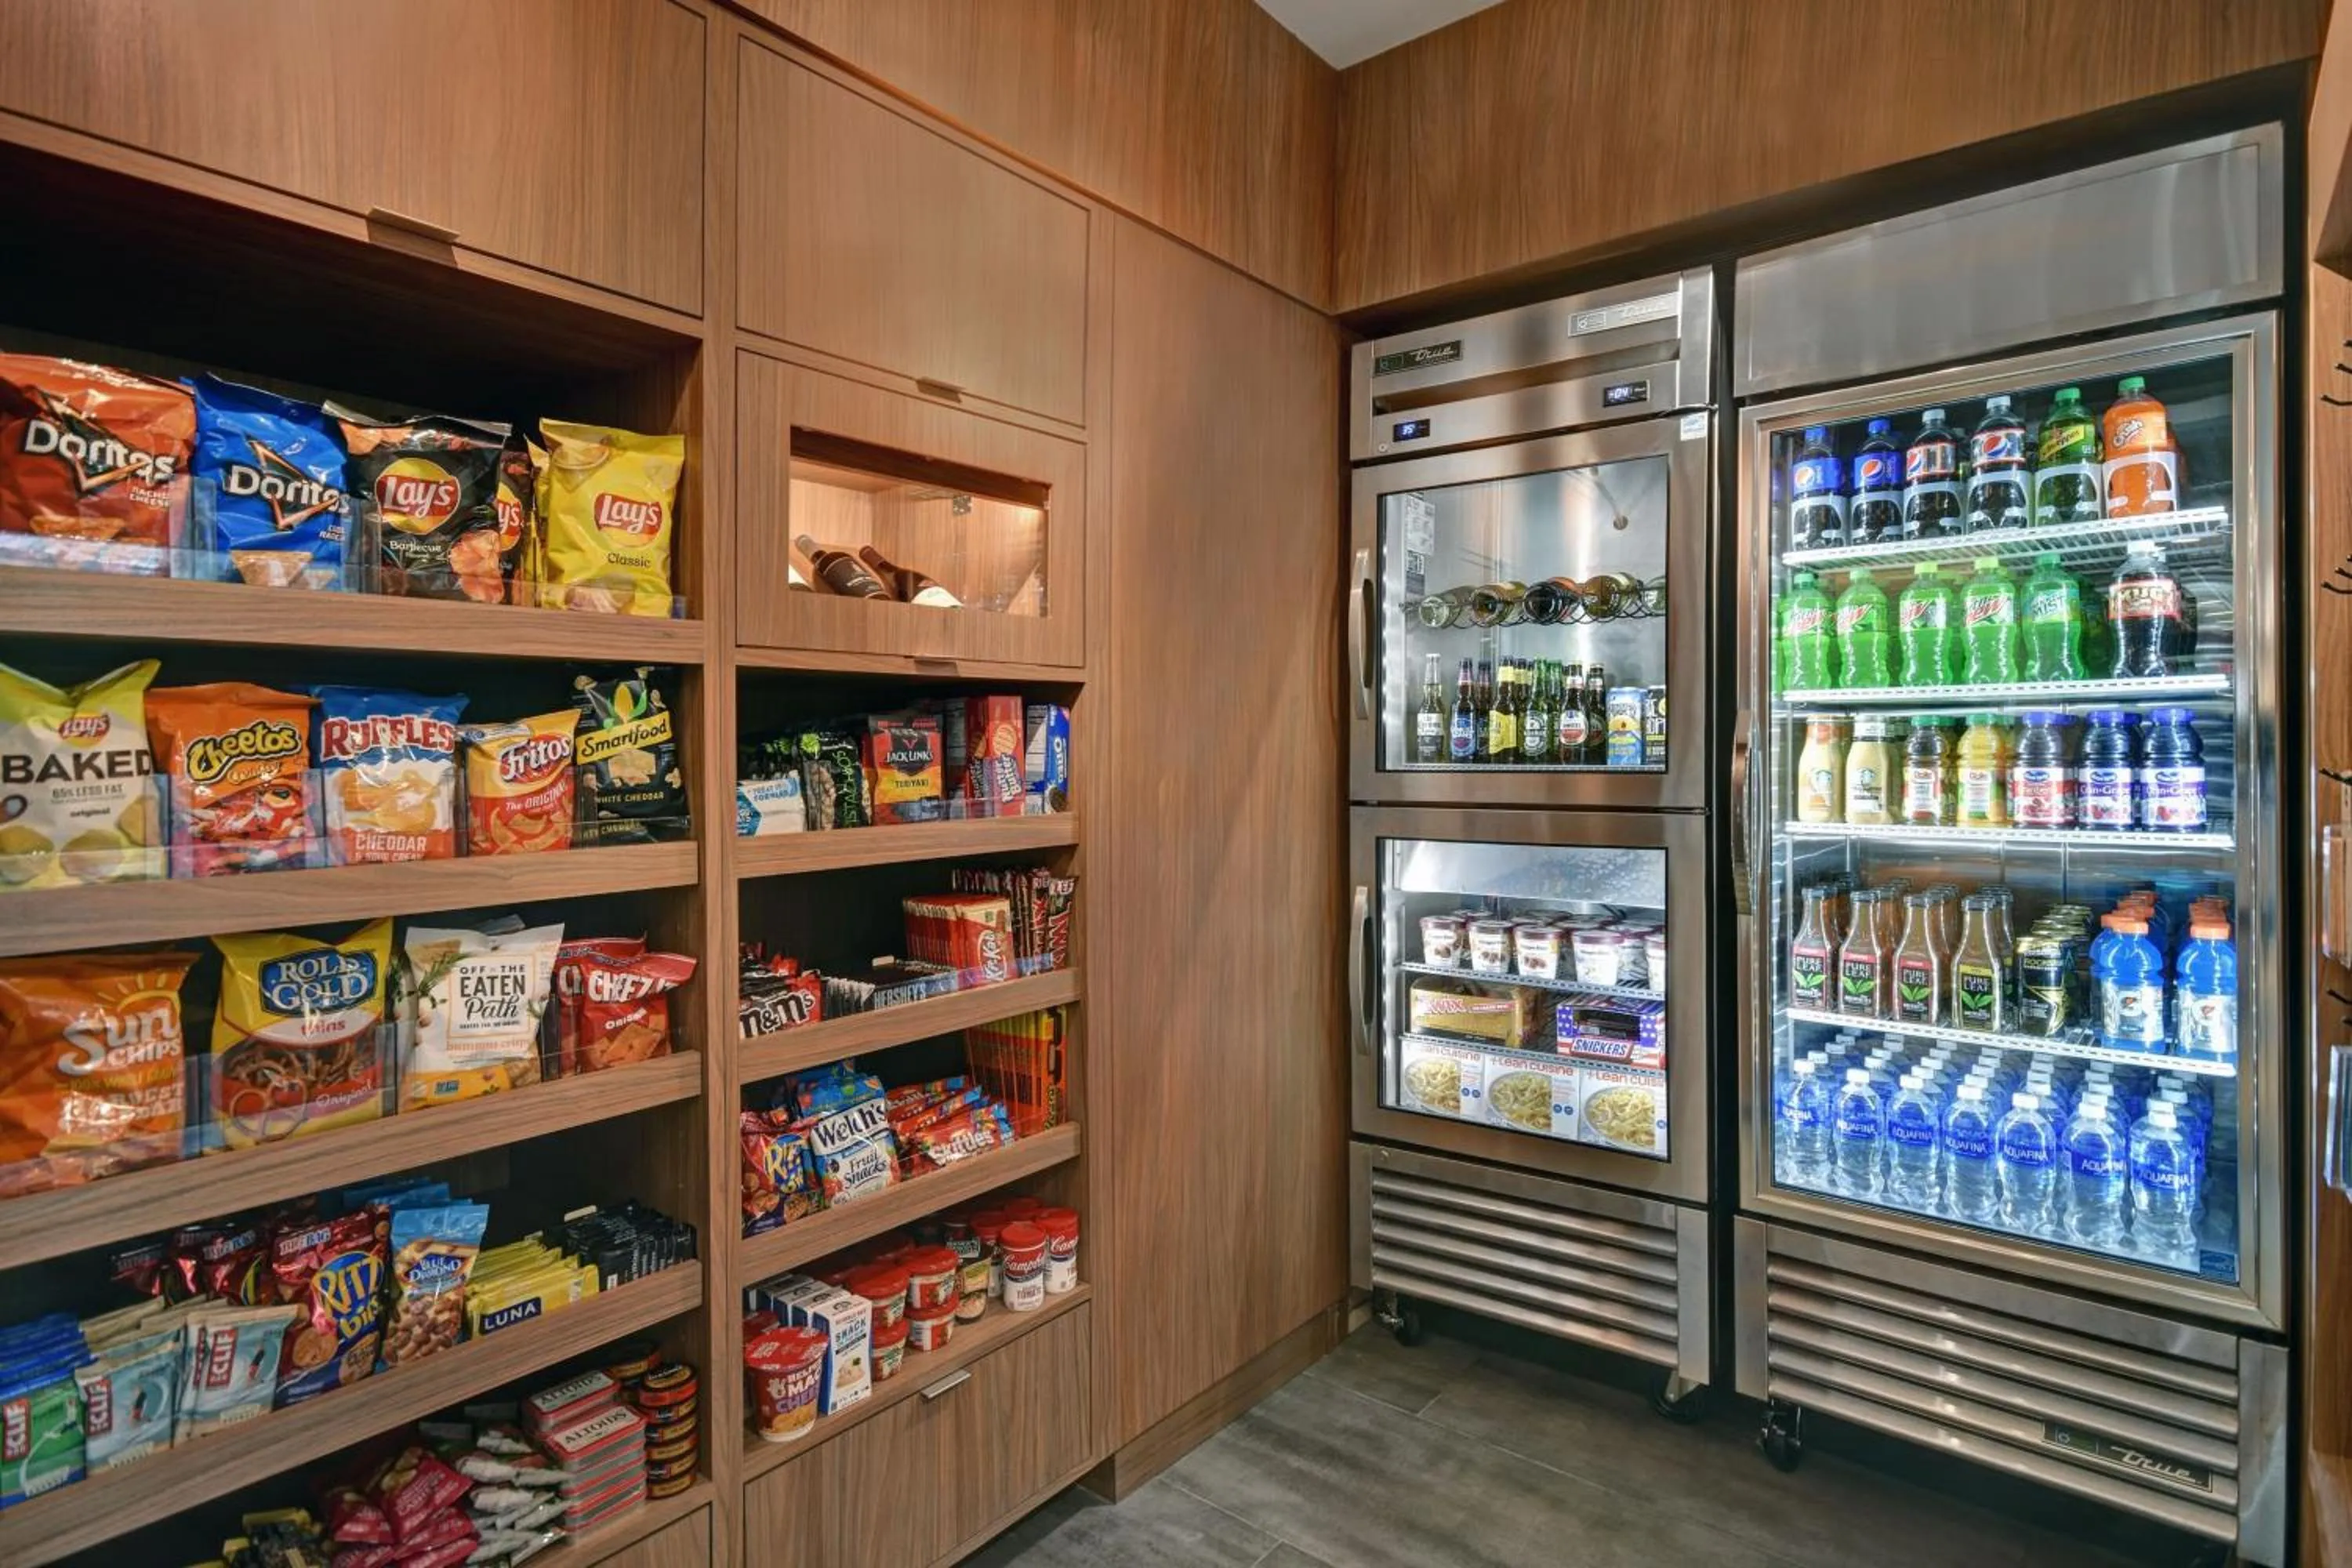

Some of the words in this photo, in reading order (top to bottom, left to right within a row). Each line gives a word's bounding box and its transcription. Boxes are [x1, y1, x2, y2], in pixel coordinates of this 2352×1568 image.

[1410, 345, 1454, 361] True
[24, 419, 176, 482] Doritos
[229, 465, 351, 514] Doritos
[384, 476, 455, 518] Lay's
[601, 495, 659, 533] Lay's
[607, 553, 652, 569] Classic
[321, 715, 455, 759] RUFFLES
[582, 721, 666, 757] Smartfood
[2, 750, 151, 783] BAKED
[187, 725, 299, 783] Cheetos
[501, 737, 572, 781] Fritos
[355, 833, 427, 852] CHEDDAR
[459, 965, 486, 975] OFF
[500, 964, 525, 974] THE
[272, 971, 368, 1011] GOLD
[460, 975, 526, 998] EATEN
[464, 994, 521, 1020] Path
[57, 1006, 180, 1076] Sun
[107, 1037, 181, 1067] CHIPS
[1573, 1039, 1628, 1058] SNICKERS
[1499, 1057, 1529, 1071] Lean
[1529, 1059, 1574, 1076] cuisine
[1595, 1070, 1629, 1084] Lean
[813, 1098, 887, 1148] Welch's
[844, 1159, 887, 1189] Snacks
[311, 1254, 380, 1320] RITZ
[485, 1301, 536, 1331] LUNA
[541, 1374, 602, 1406] ALTOIDS
[564, 1410, 628, 1444] ALTOIDS
[2110, 1445, 2191, 1478] True
